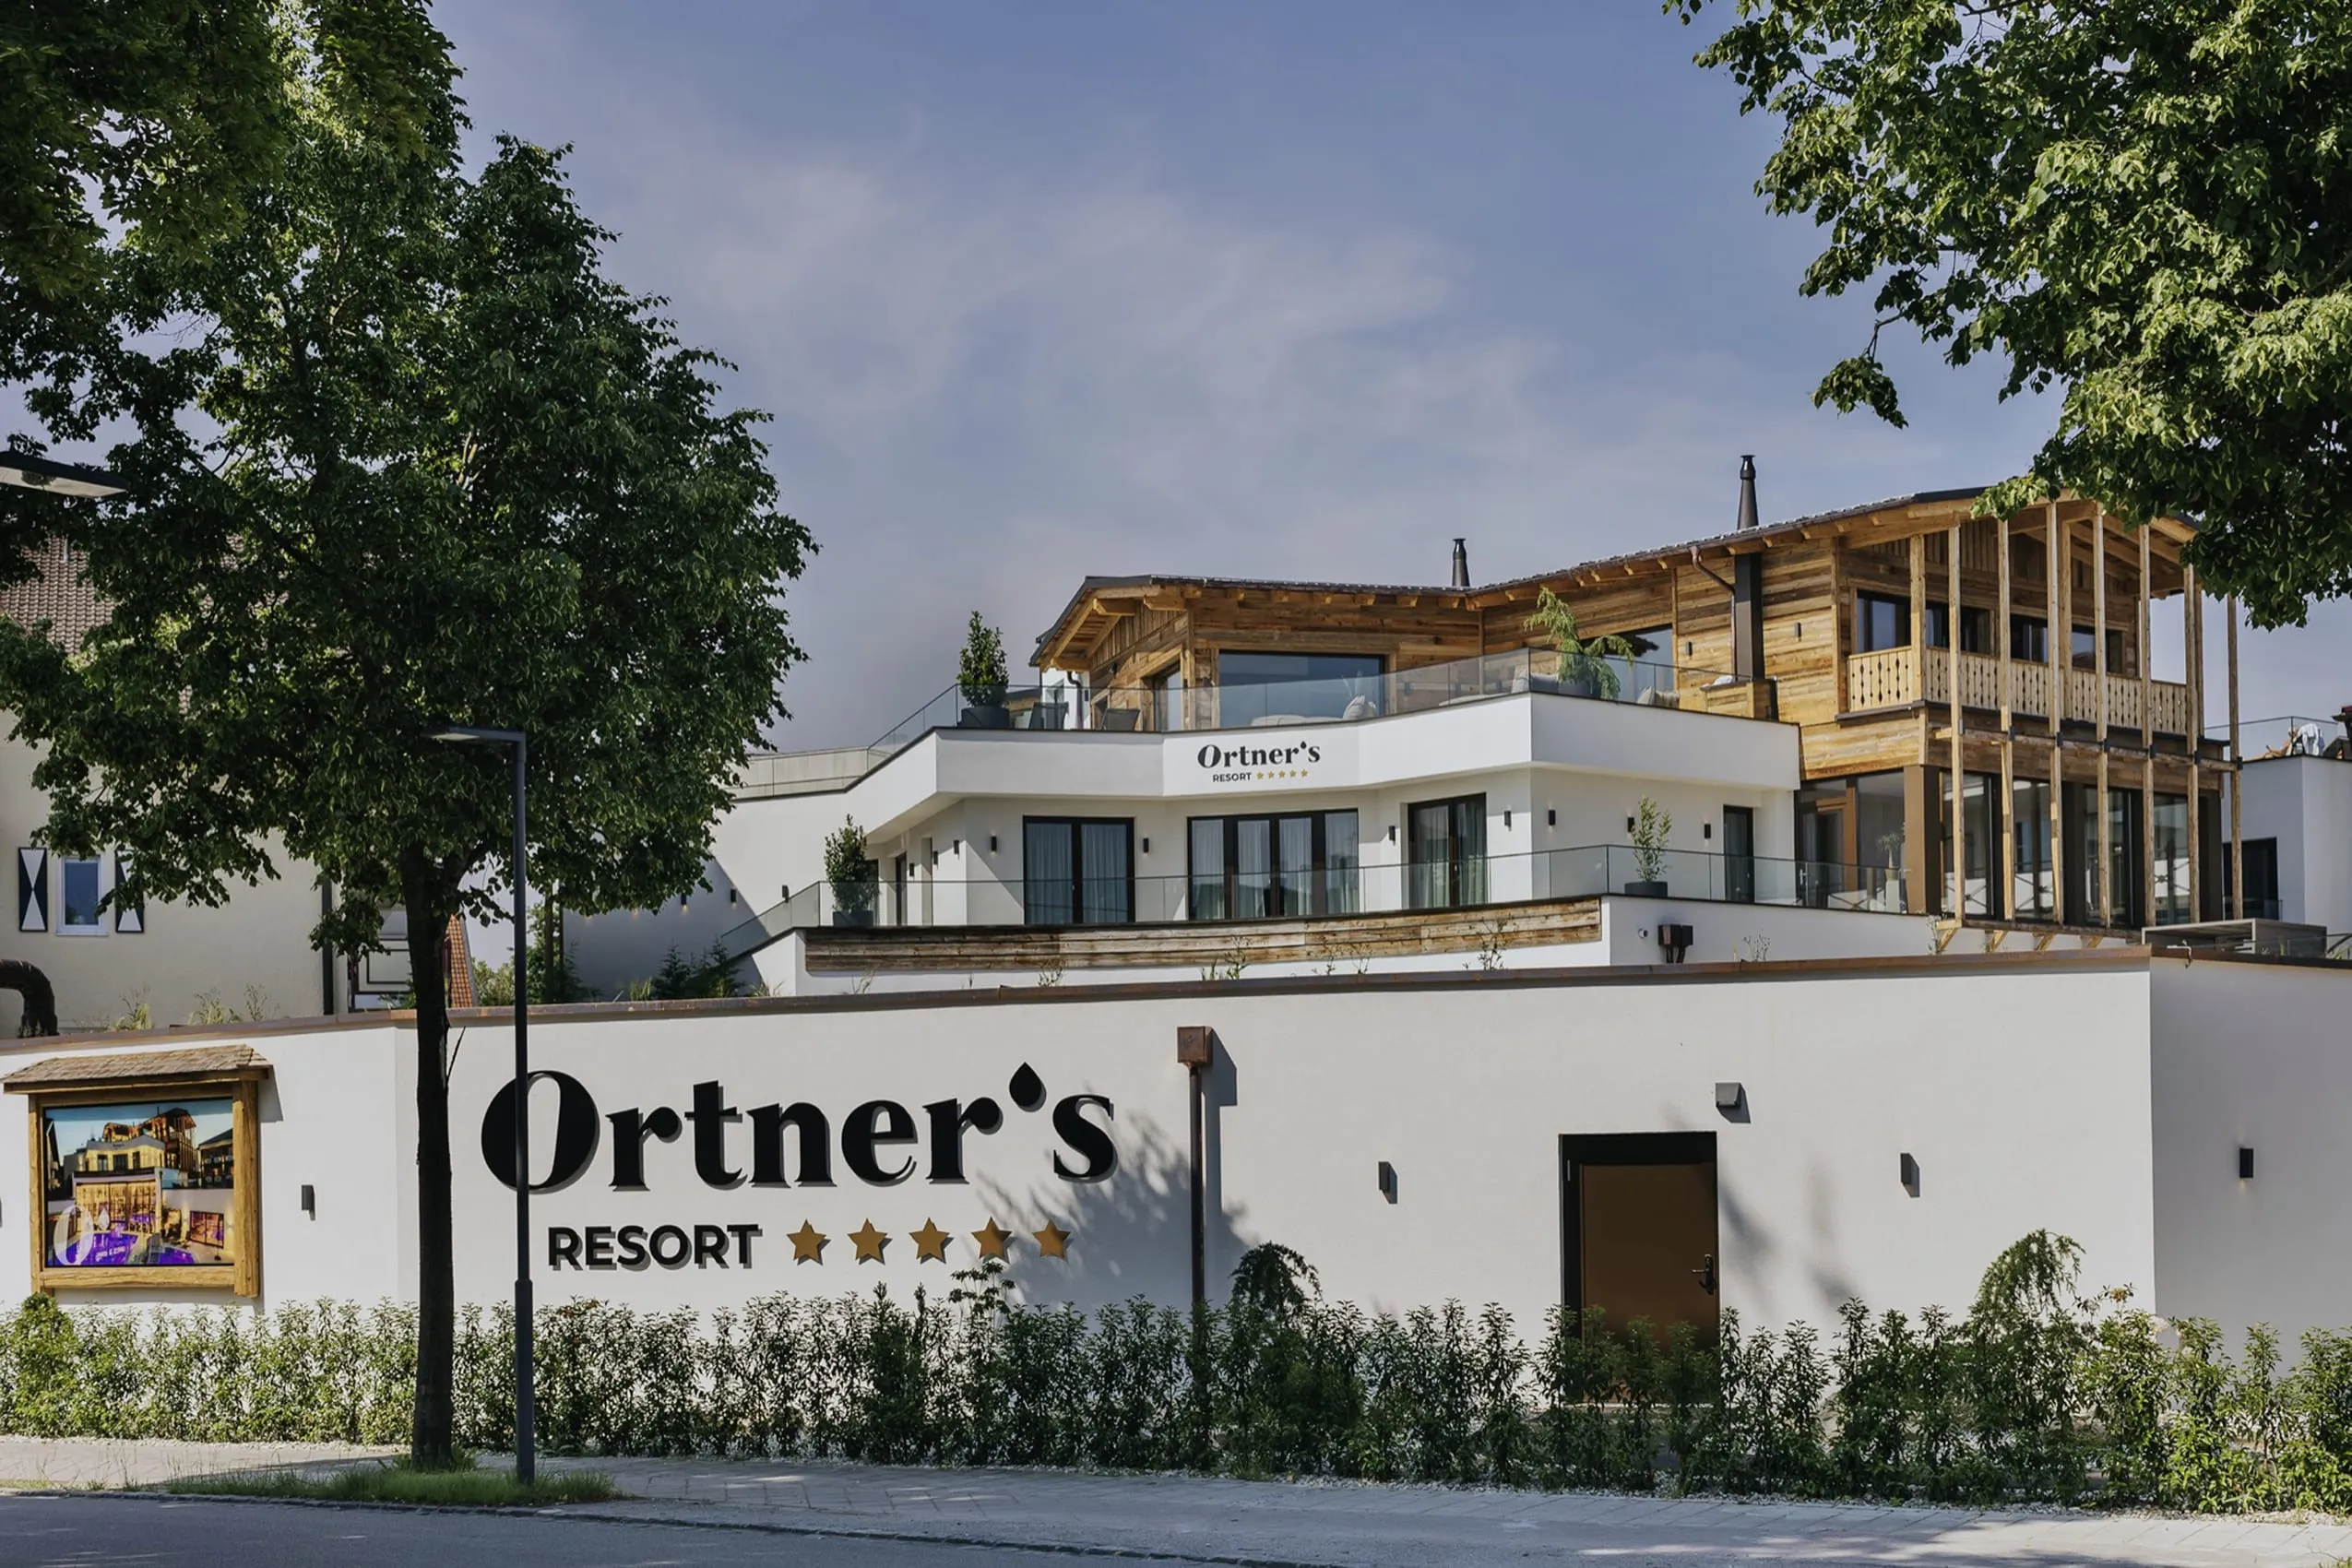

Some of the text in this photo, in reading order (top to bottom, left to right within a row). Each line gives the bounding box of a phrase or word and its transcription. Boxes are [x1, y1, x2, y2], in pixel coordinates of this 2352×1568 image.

[1197, 741, 1321, 768] Ortner's
[1212, 771, 1253, 783] RESORT
[481, 1062, 1116, 1192] Ortner's
[548, 1223, 759, 1268] RESORT
